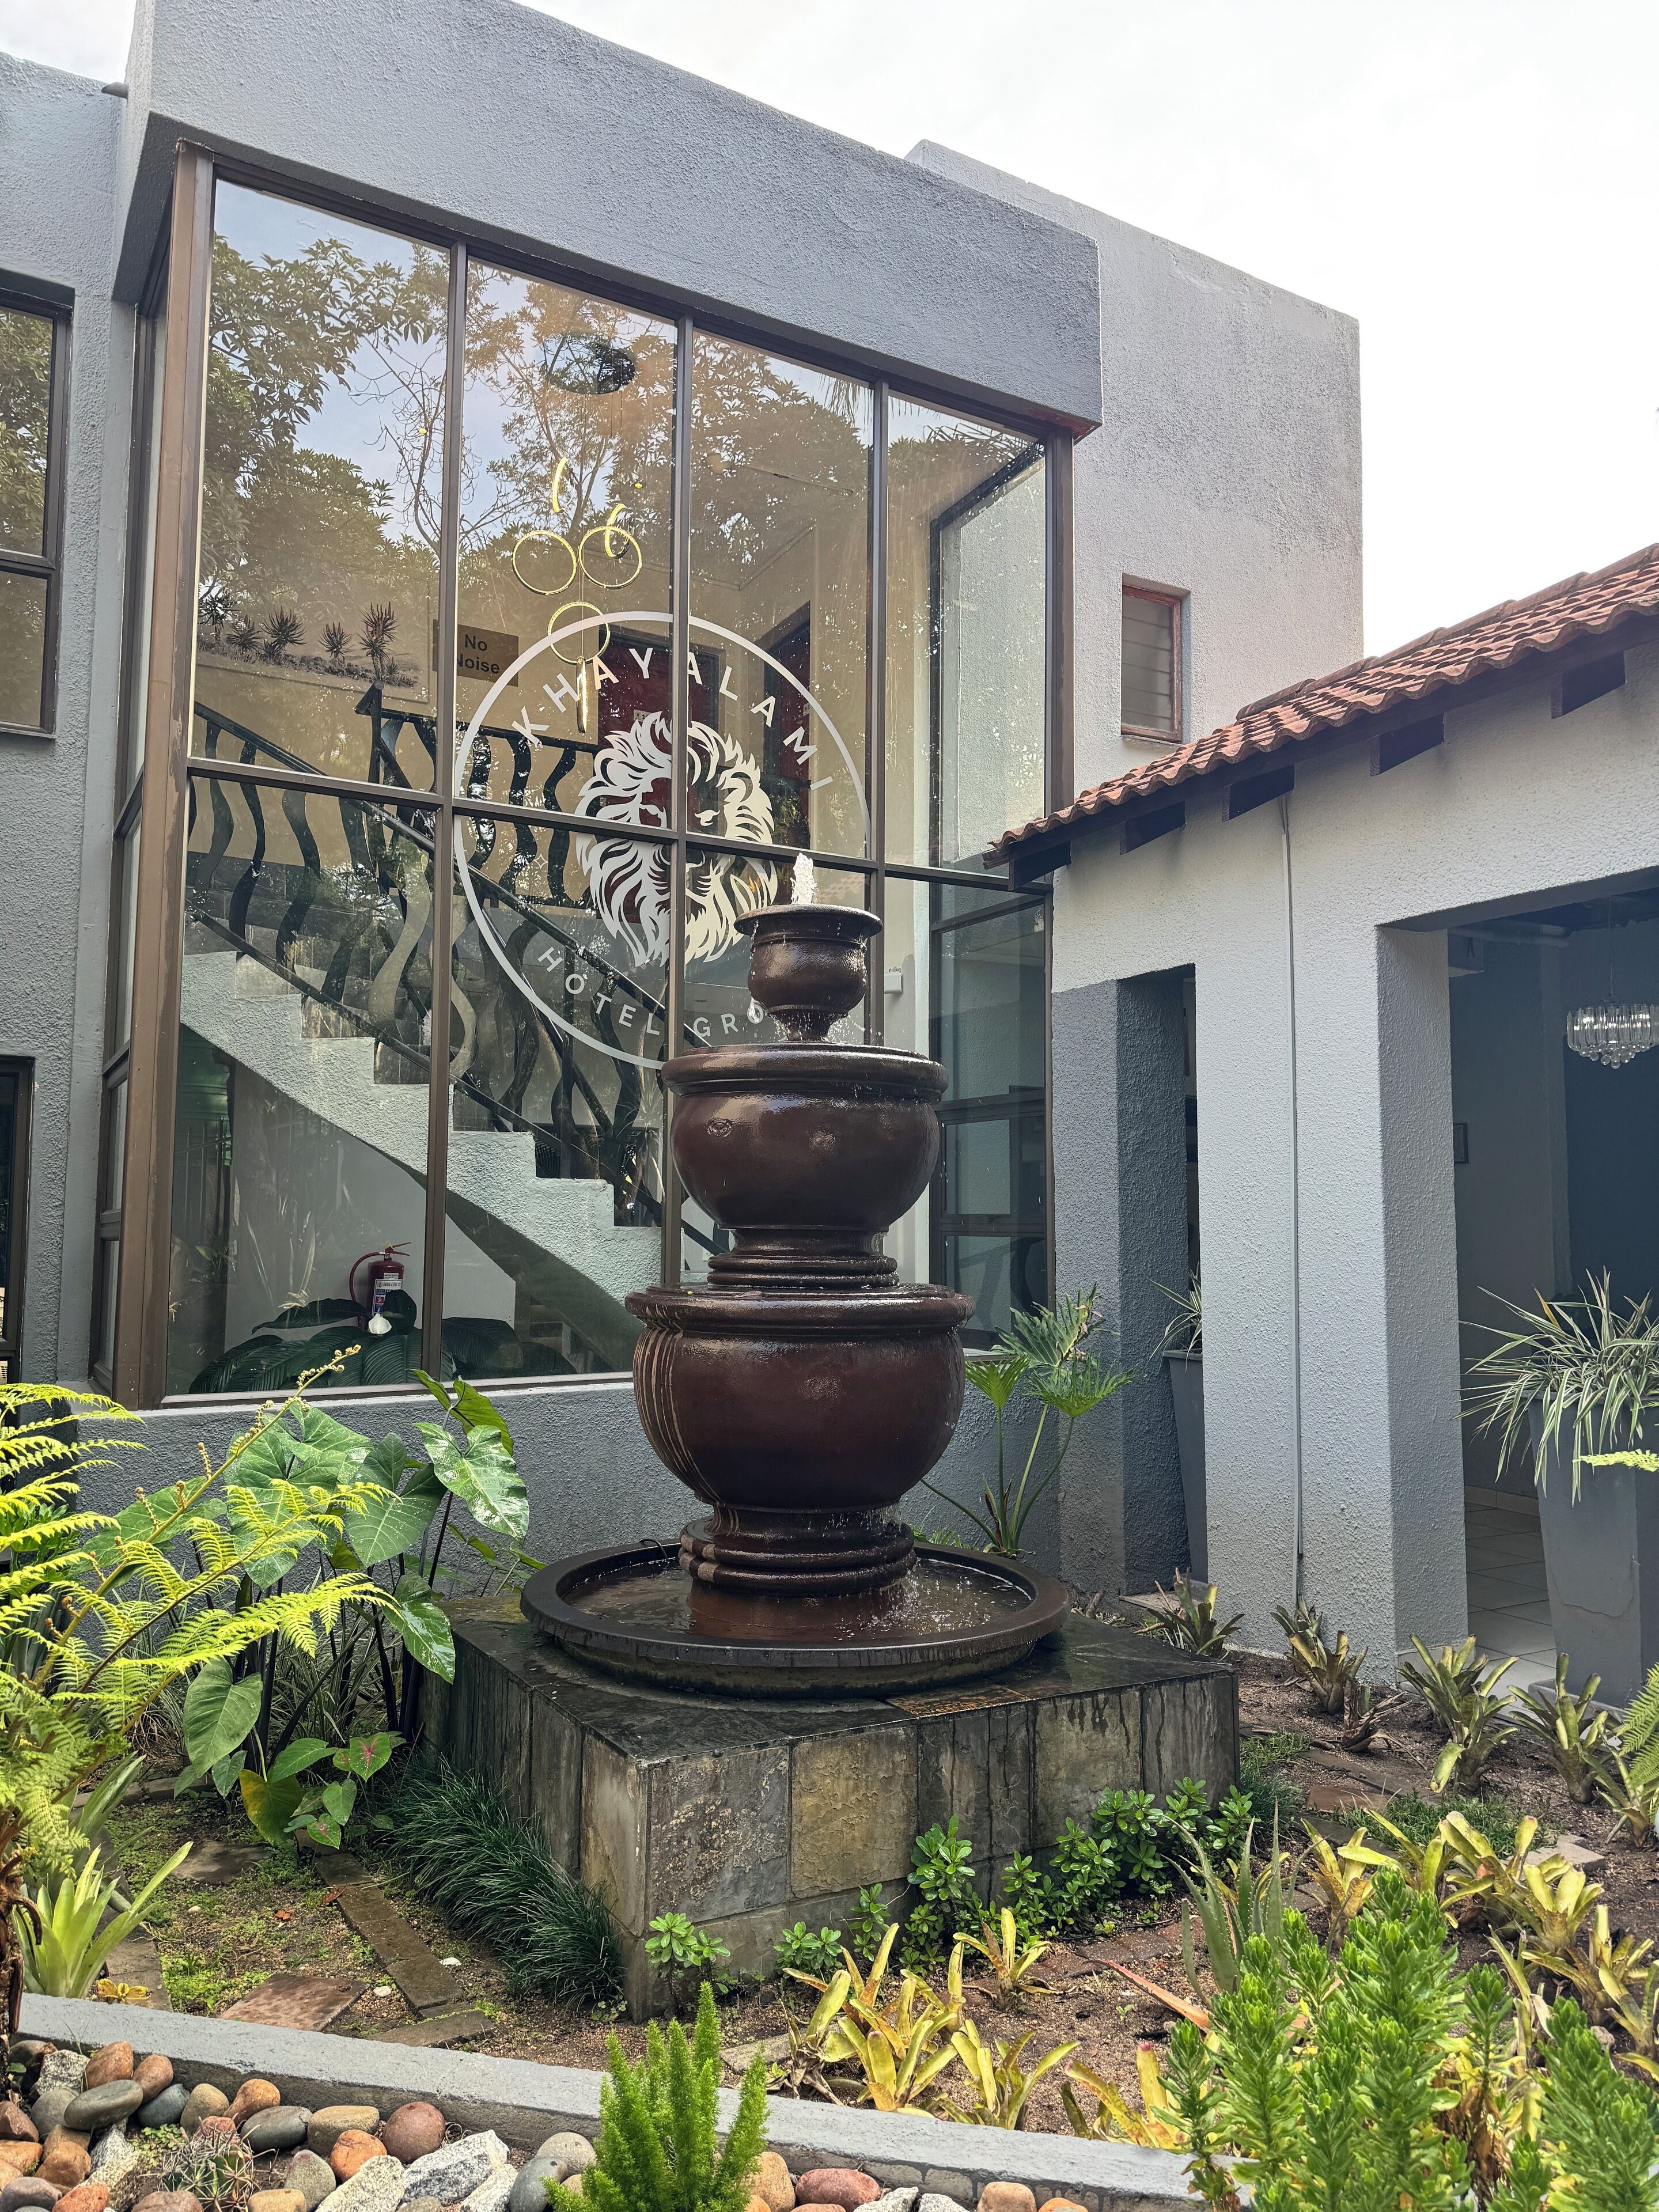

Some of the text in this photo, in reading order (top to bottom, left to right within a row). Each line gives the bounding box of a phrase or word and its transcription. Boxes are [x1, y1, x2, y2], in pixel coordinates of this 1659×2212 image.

[465, 634, 487, 651] No
[511, 647, 833, 790] KHAYALAMI
[537, 946, 764, 1037] HOTEL GRO
